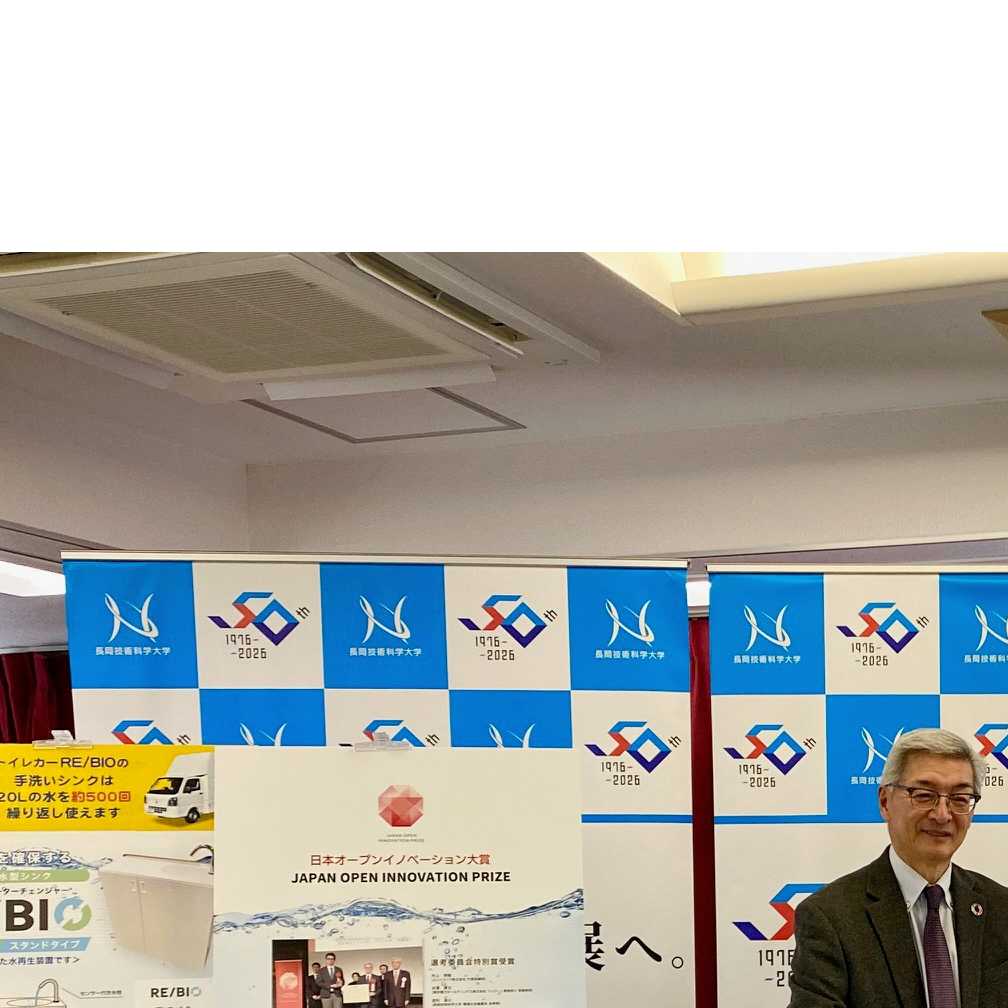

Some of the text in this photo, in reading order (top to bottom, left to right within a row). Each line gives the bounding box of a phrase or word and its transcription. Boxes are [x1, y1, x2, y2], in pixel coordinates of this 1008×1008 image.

[96, 647, 171, 655] 長岡技術科学大学
[231, 648, 266, 659] -2026
[350, 647, 422, 656] 長岡技術科学大学
[480, 650, 515, 661] -2026
[595, 650, 665, 660] 長岡技術科学大学
[734, 655, 800, 664] 長岡技術科学大学
[855, 655, 889, 666] -2026
[14, 775, 113, 787] 手洗いシンクは
[605, 774, 640, 785] -2026
[743, 777, 776, 788] -2026
[7, 808, 120, 819] 繰り返し使えます
[310, 854, 491, 866] 日本オープンイノベーション大賞
[291, 871, 511, 883] JAPAN OPEN INNOVATION PRIZE
[10, 941, 80, 950] スタンドタイプ
